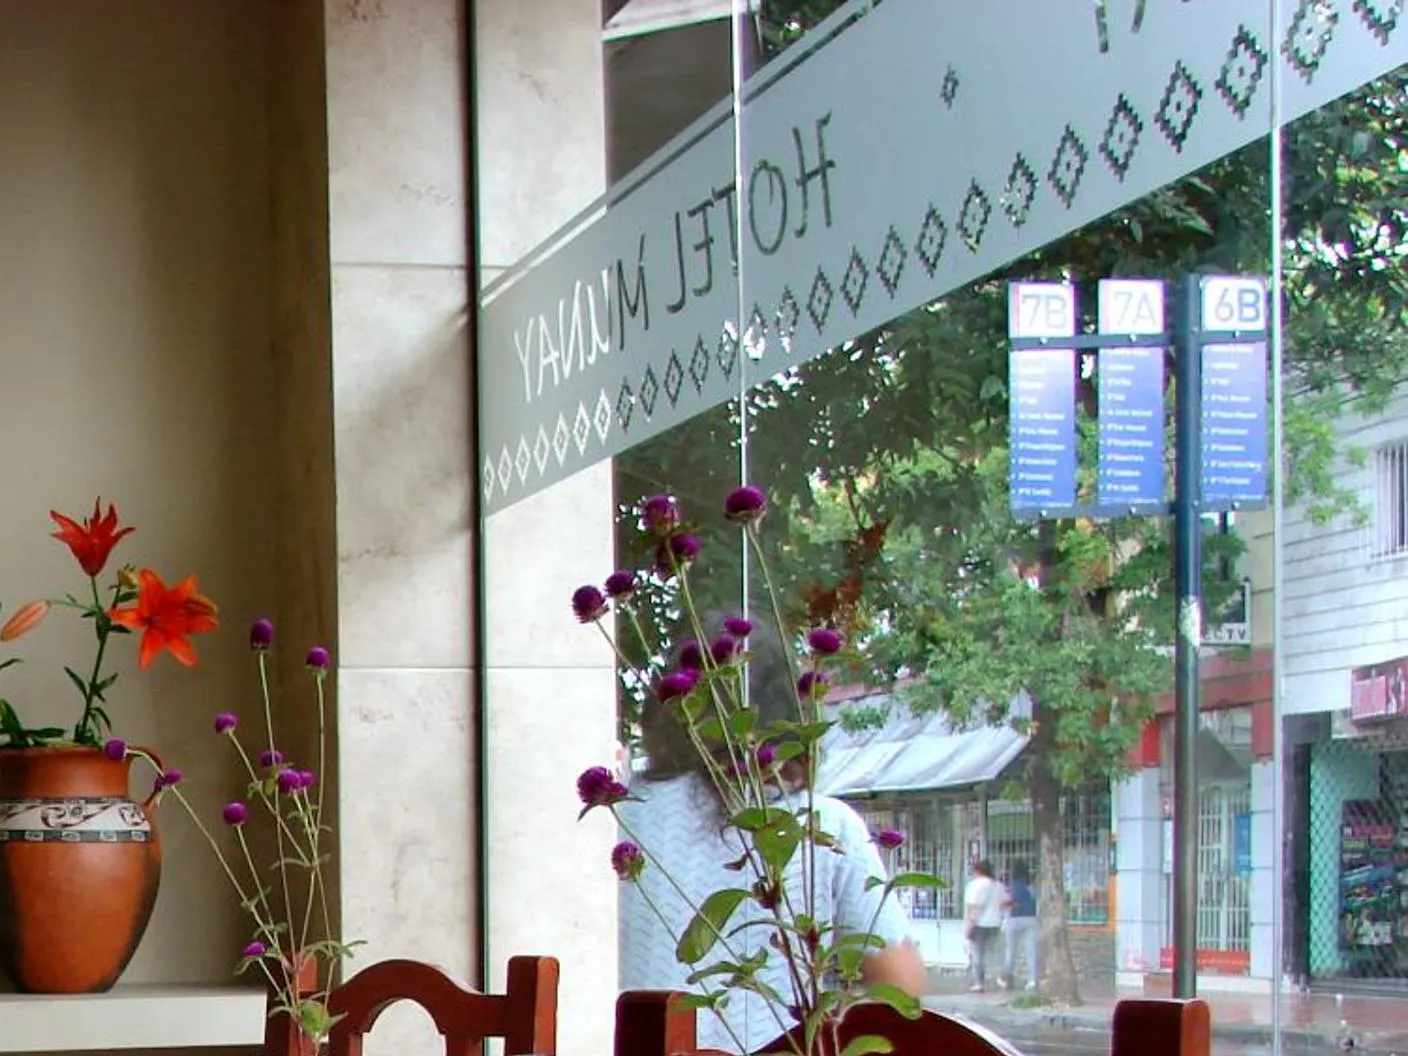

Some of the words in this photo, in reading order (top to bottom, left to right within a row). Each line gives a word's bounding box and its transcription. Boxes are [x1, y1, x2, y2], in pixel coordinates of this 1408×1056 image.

[1021, 294, 1068, 329] 7B
[1114, 291, 1157, 327] 7A
[1213, 287, 1261, 323] 6B
